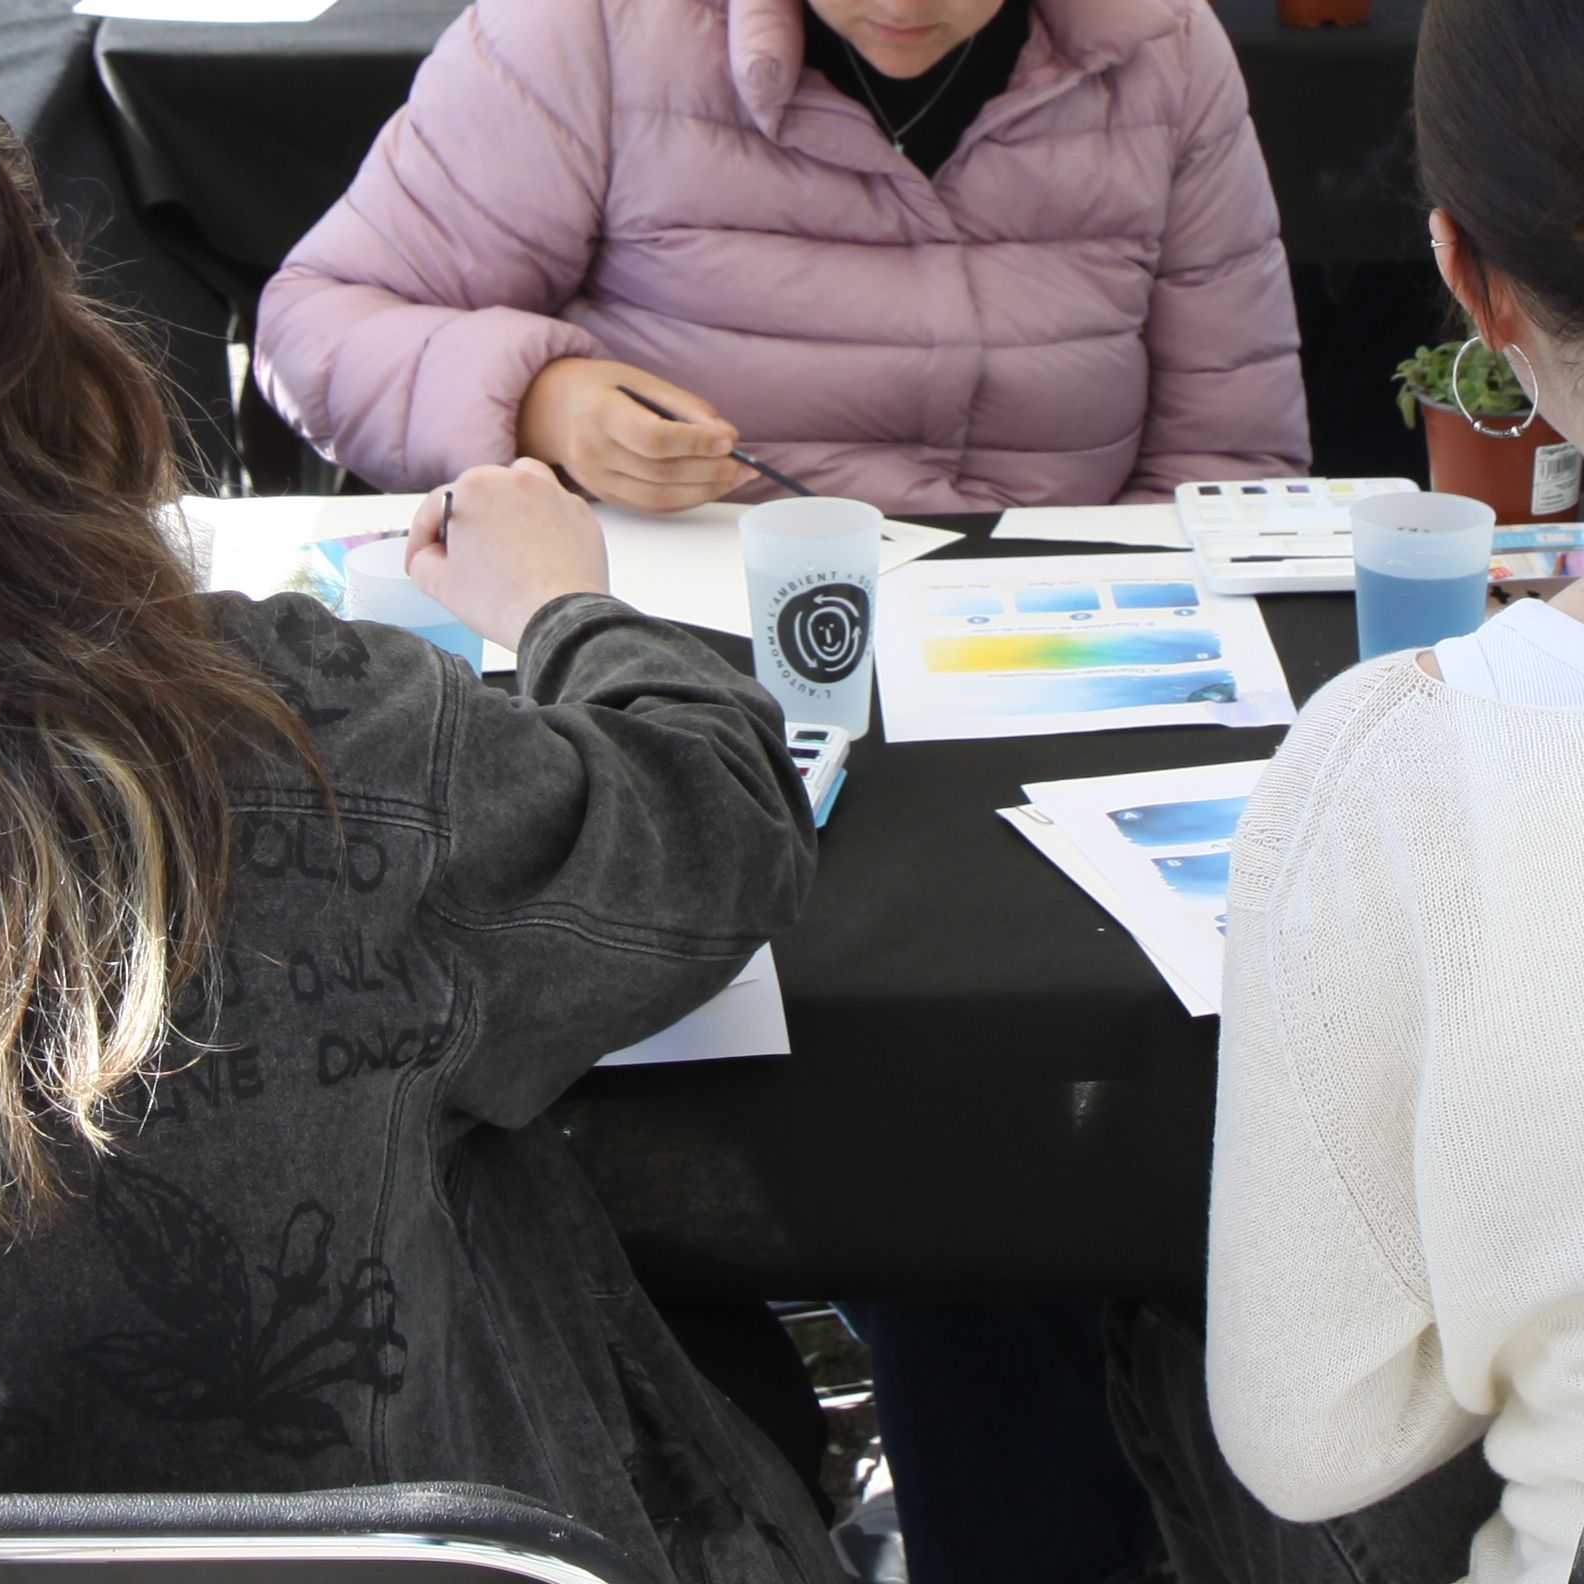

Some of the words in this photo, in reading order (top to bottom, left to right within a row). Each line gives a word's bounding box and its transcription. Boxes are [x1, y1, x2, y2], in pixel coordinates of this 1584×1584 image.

[767, 570, 837, 618] L'AMBIENT
[288, 926, 417, 1003] ONLY
[318, 1020, 456, 1087] ONCE
